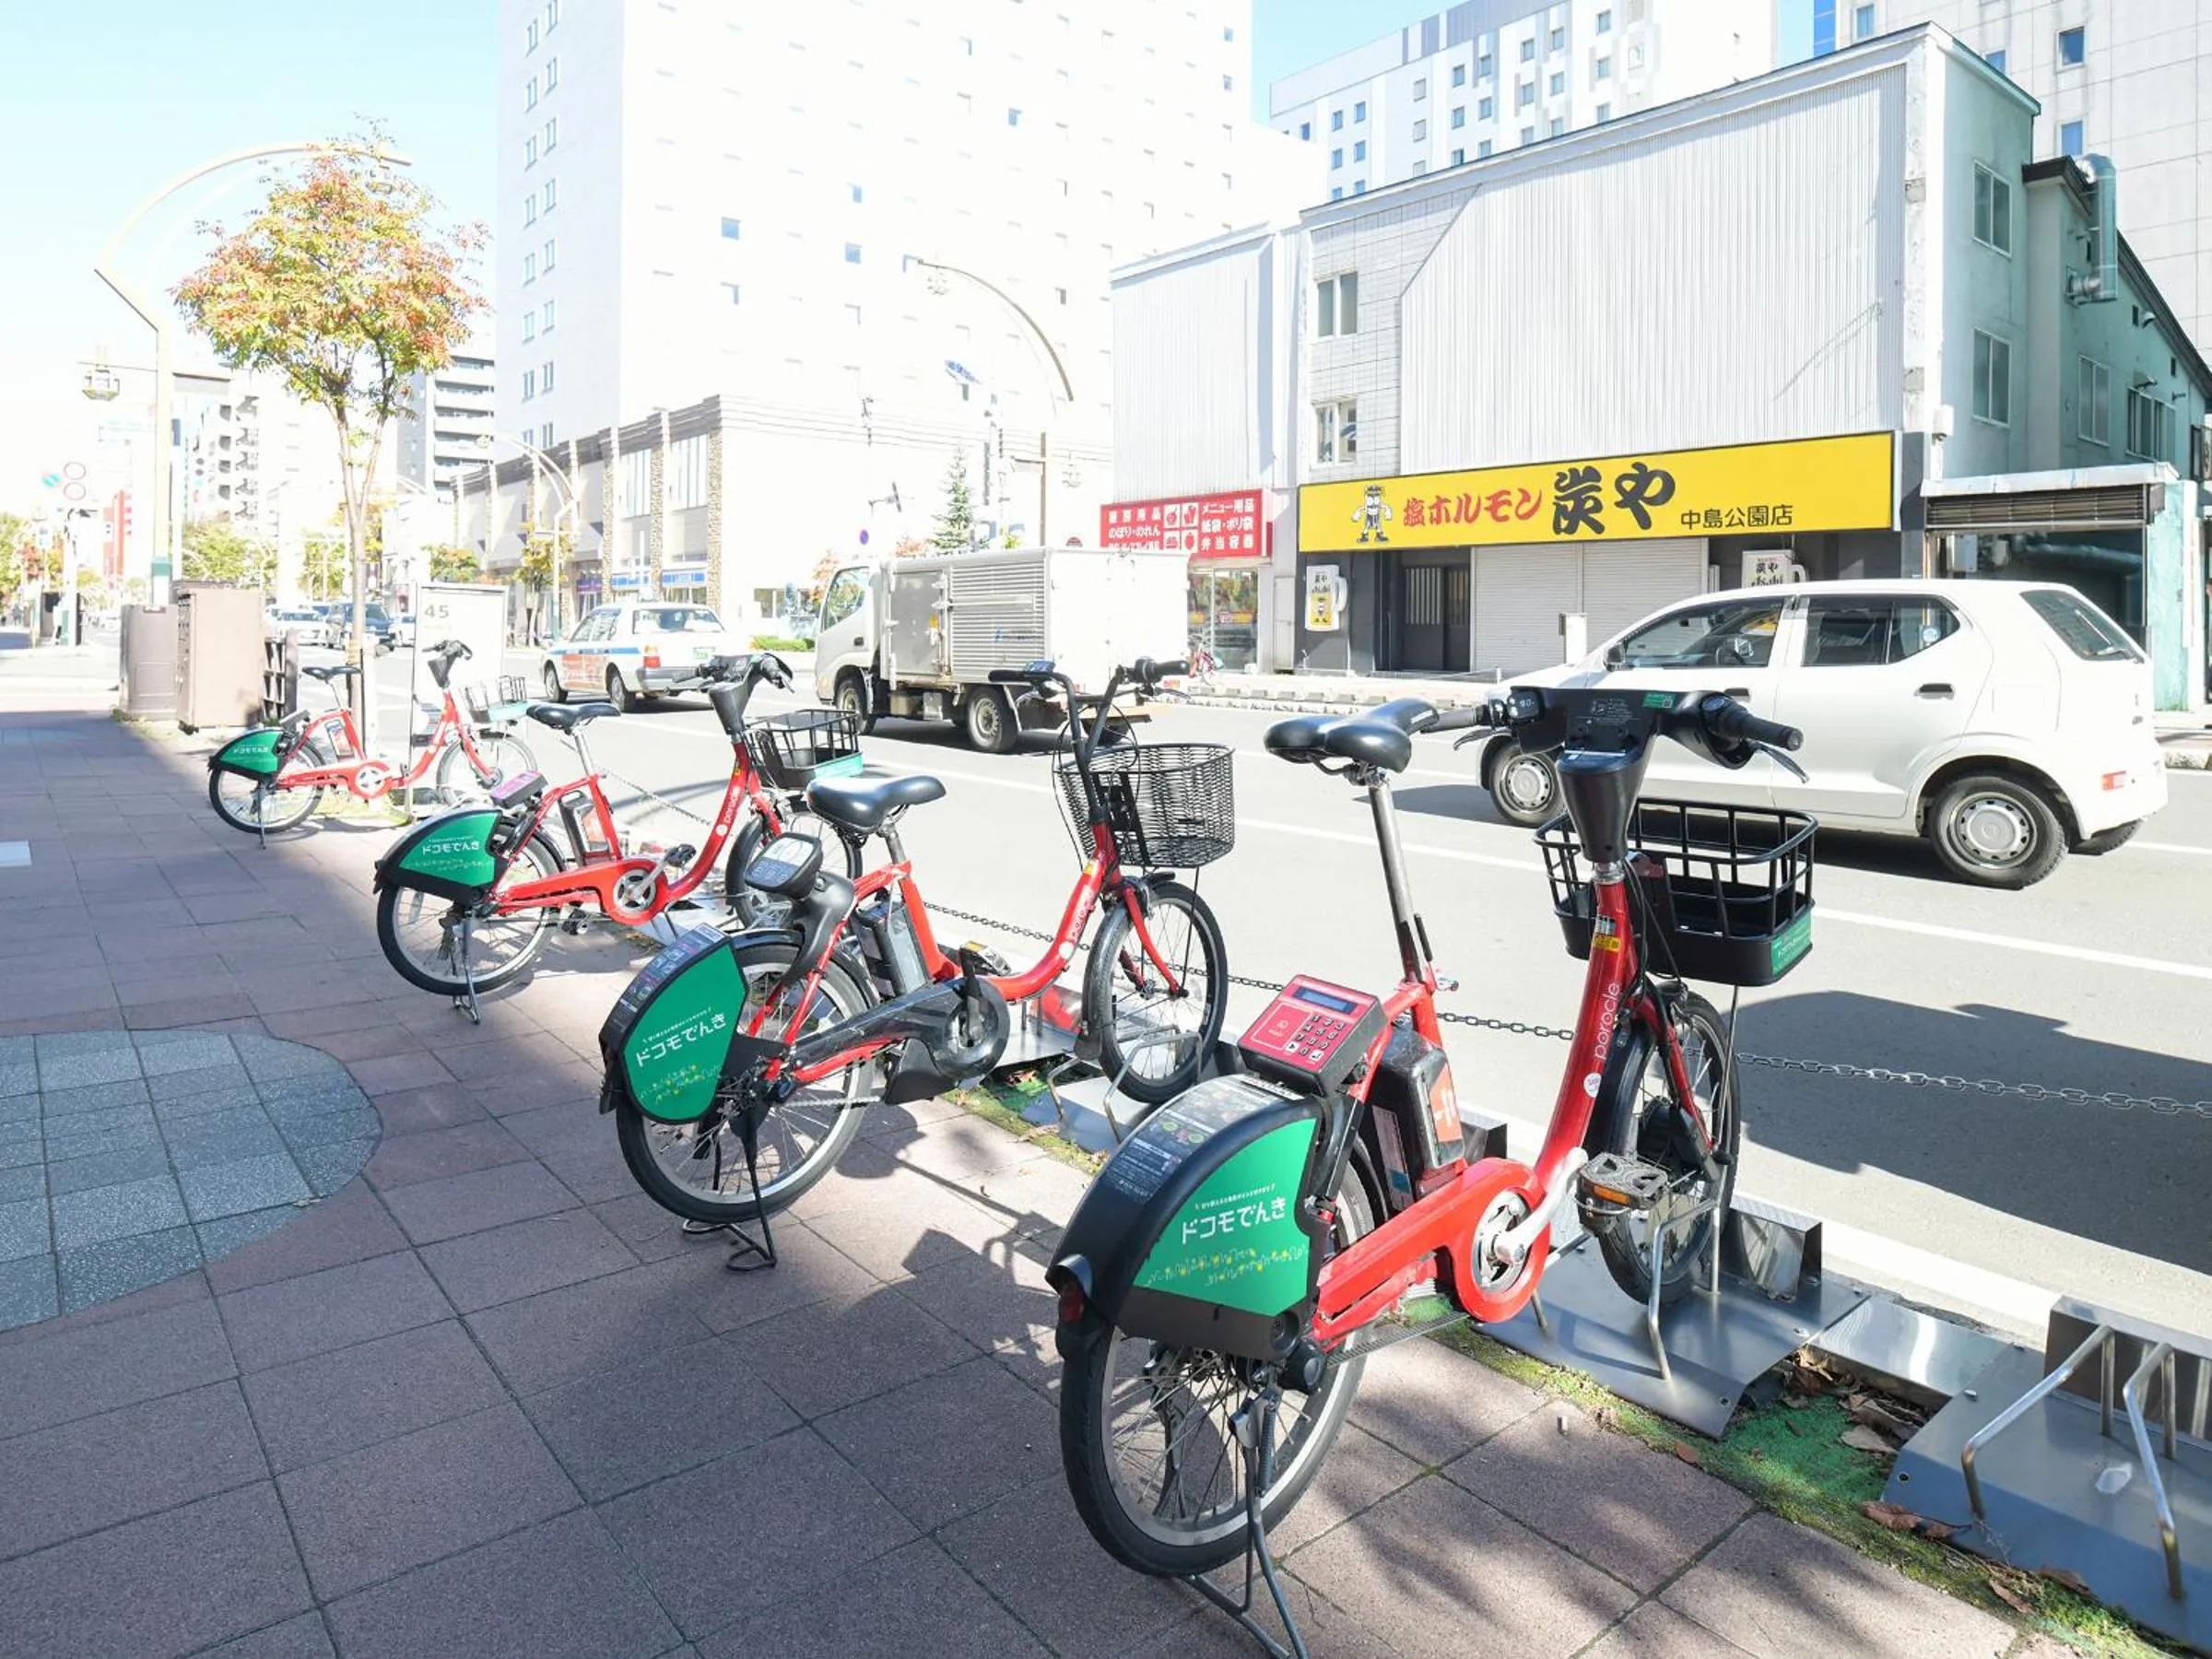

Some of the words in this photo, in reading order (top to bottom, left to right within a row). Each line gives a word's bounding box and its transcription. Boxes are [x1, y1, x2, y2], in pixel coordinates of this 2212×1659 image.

[1403, 488, 1543, 527] 塩ホルモン
[1551, 461, 1677, 536] 炭や
[1680, 504, 1794, 531] 中島公園店
[424, 604, 450, 619] 45
[636, 1013, 726, 1067] ドコモでんき
[1594, 982, 1620, 1060] porocle
[1182, 1196, 1287, 1245] ドコモでんき
